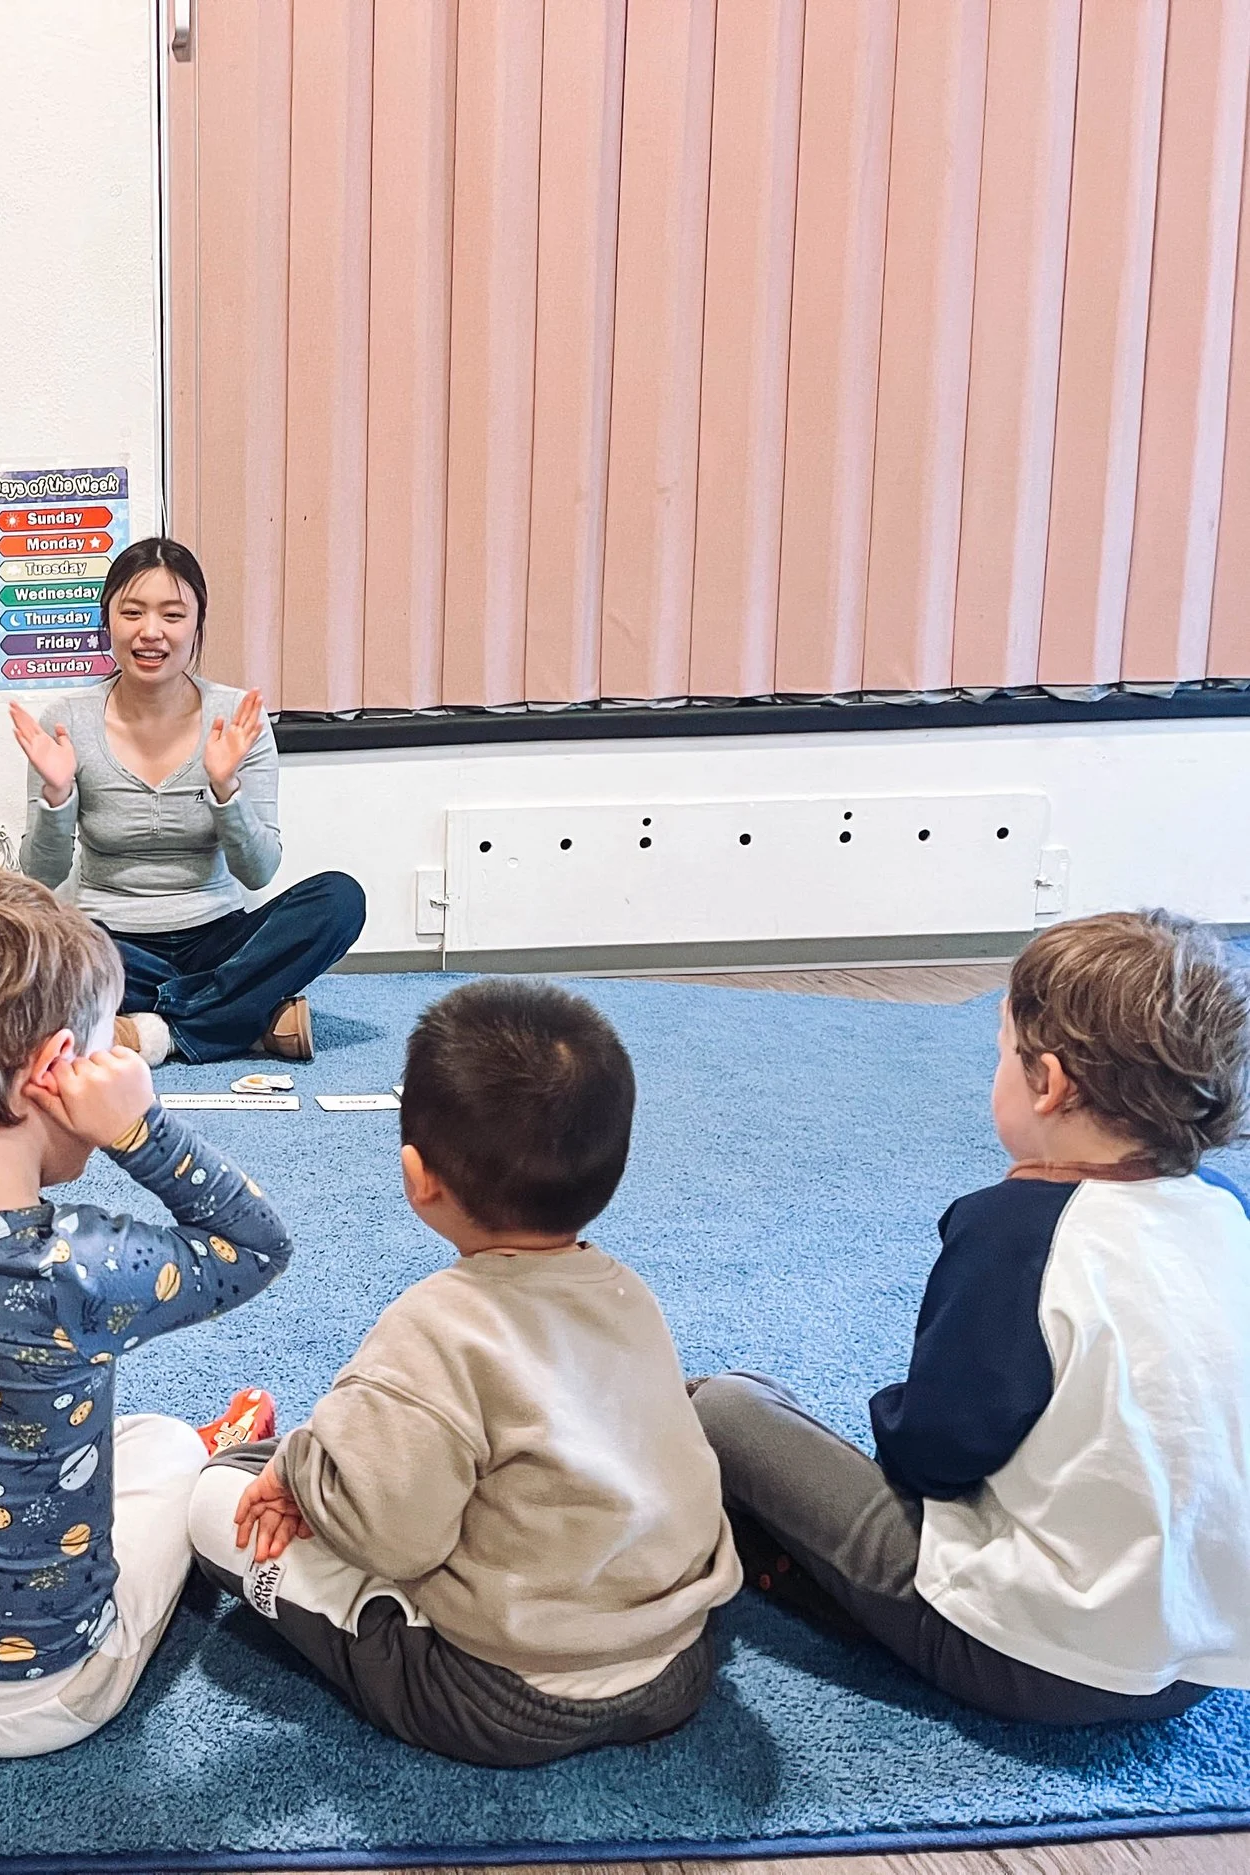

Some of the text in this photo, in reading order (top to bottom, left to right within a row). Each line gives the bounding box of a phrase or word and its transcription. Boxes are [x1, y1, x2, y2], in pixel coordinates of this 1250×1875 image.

[27, 477, 45, 495] of
[48, 475, 74, 493] the
[75, 475, 118, 493] Week
[27, 511, 83, 526] Sunday
[26, 536, 86, 552] Monday
[25, 561, 87, 577] Tuesday
[14, 586, 100, 602] Wednesday
[24, 610, 92, 626] Thursday
[35, 636, 82, 651] Friday
[26, 660, 93, 675] Saturday
[213, 1421, 247, 1447] 95
[264, 1562, 281, 1607] ALWAYS
